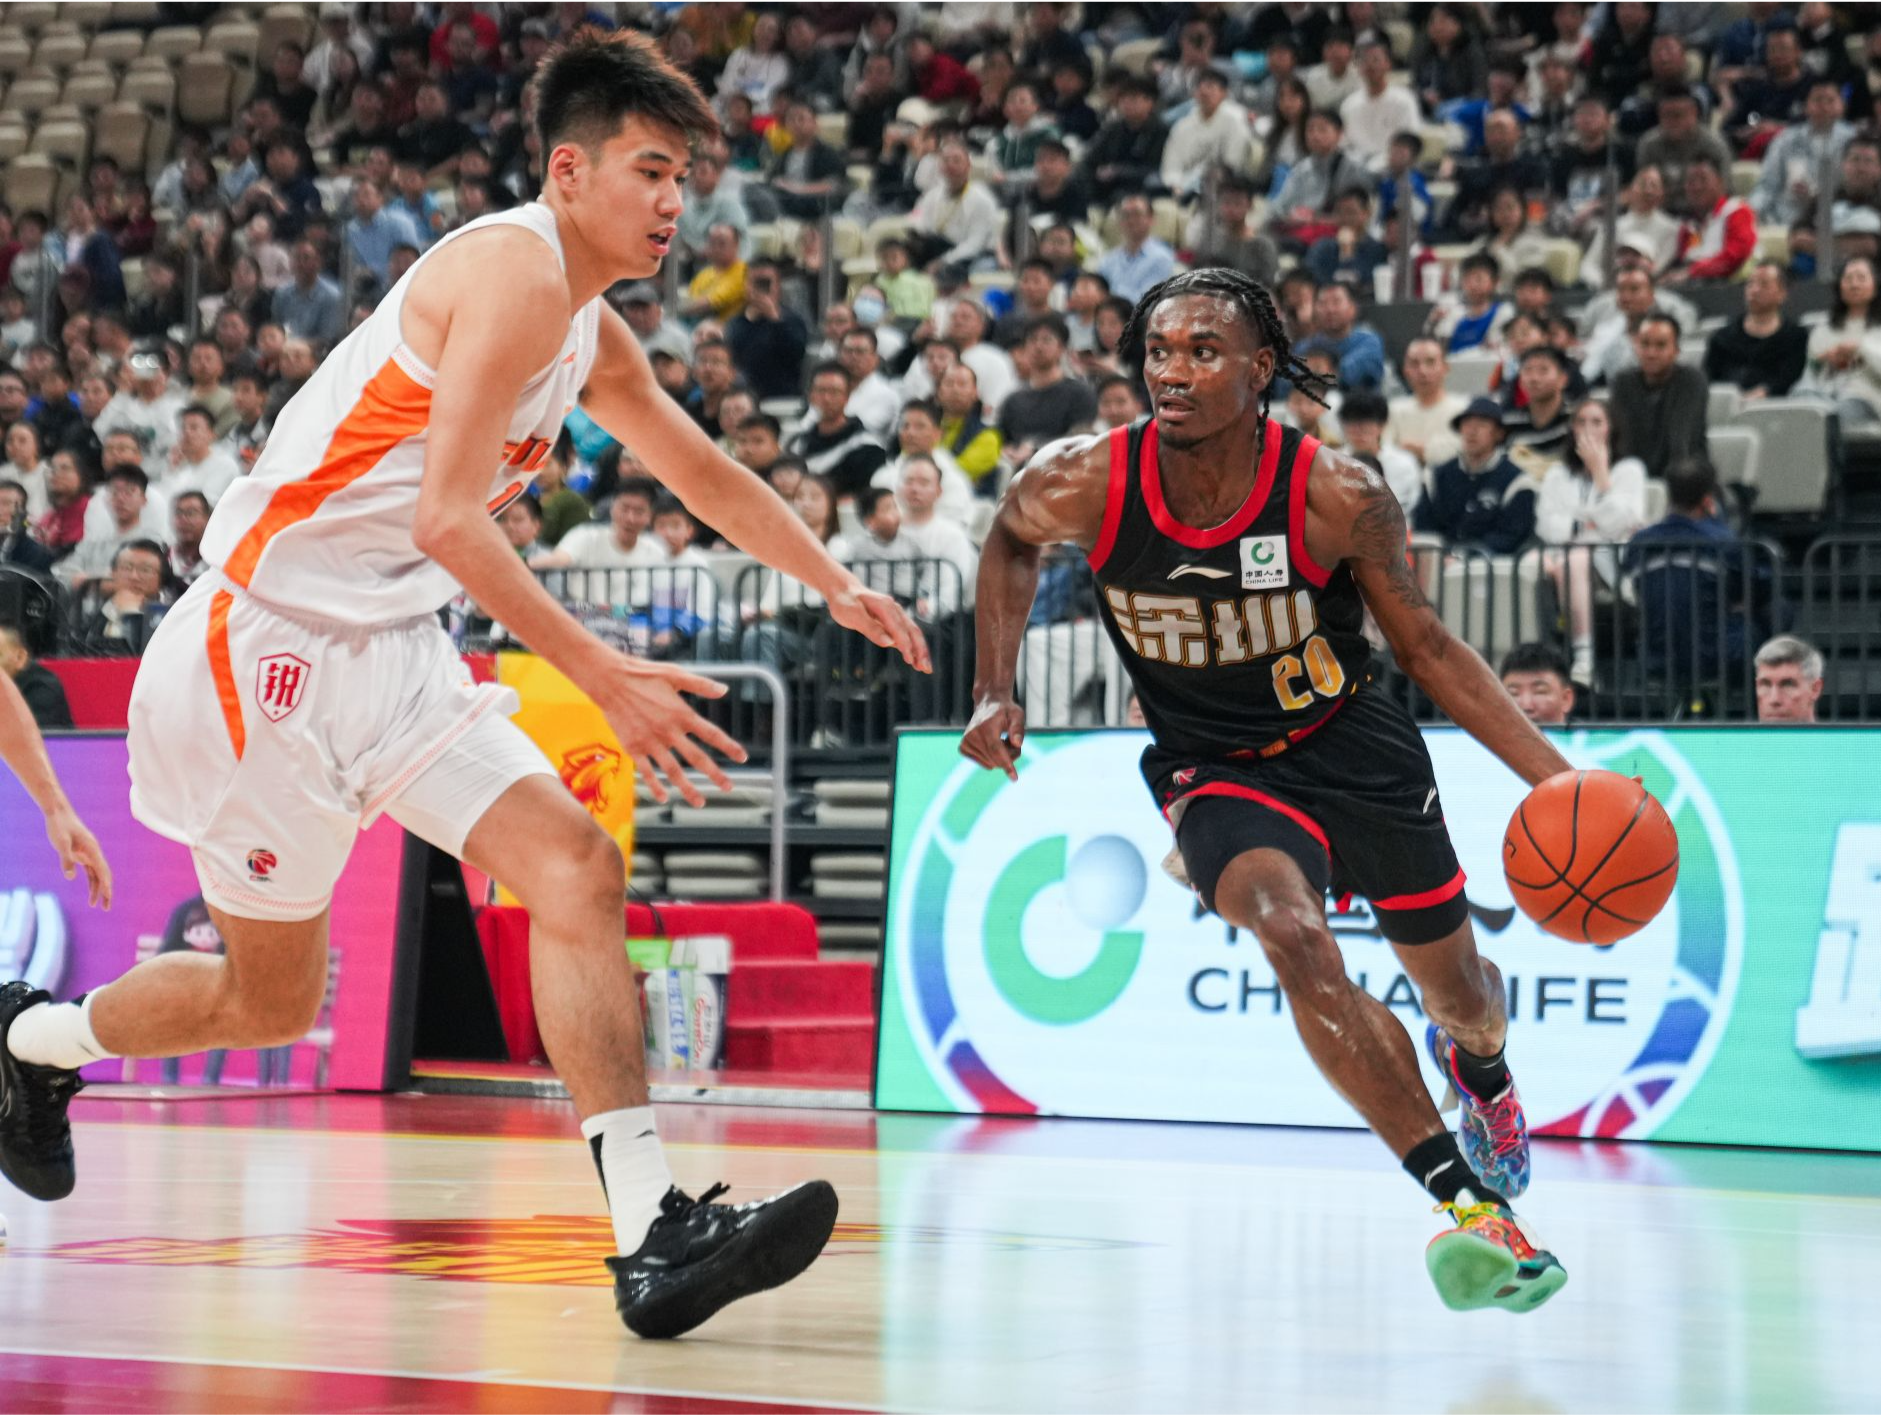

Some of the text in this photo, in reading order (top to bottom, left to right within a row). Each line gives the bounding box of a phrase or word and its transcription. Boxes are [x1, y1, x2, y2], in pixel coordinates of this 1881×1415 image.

[1104, 583, 1318, 669] 深圳
[1271, 634, 1346, 712] 20
[1187, 967, 1629, 1024] CHA IFE
